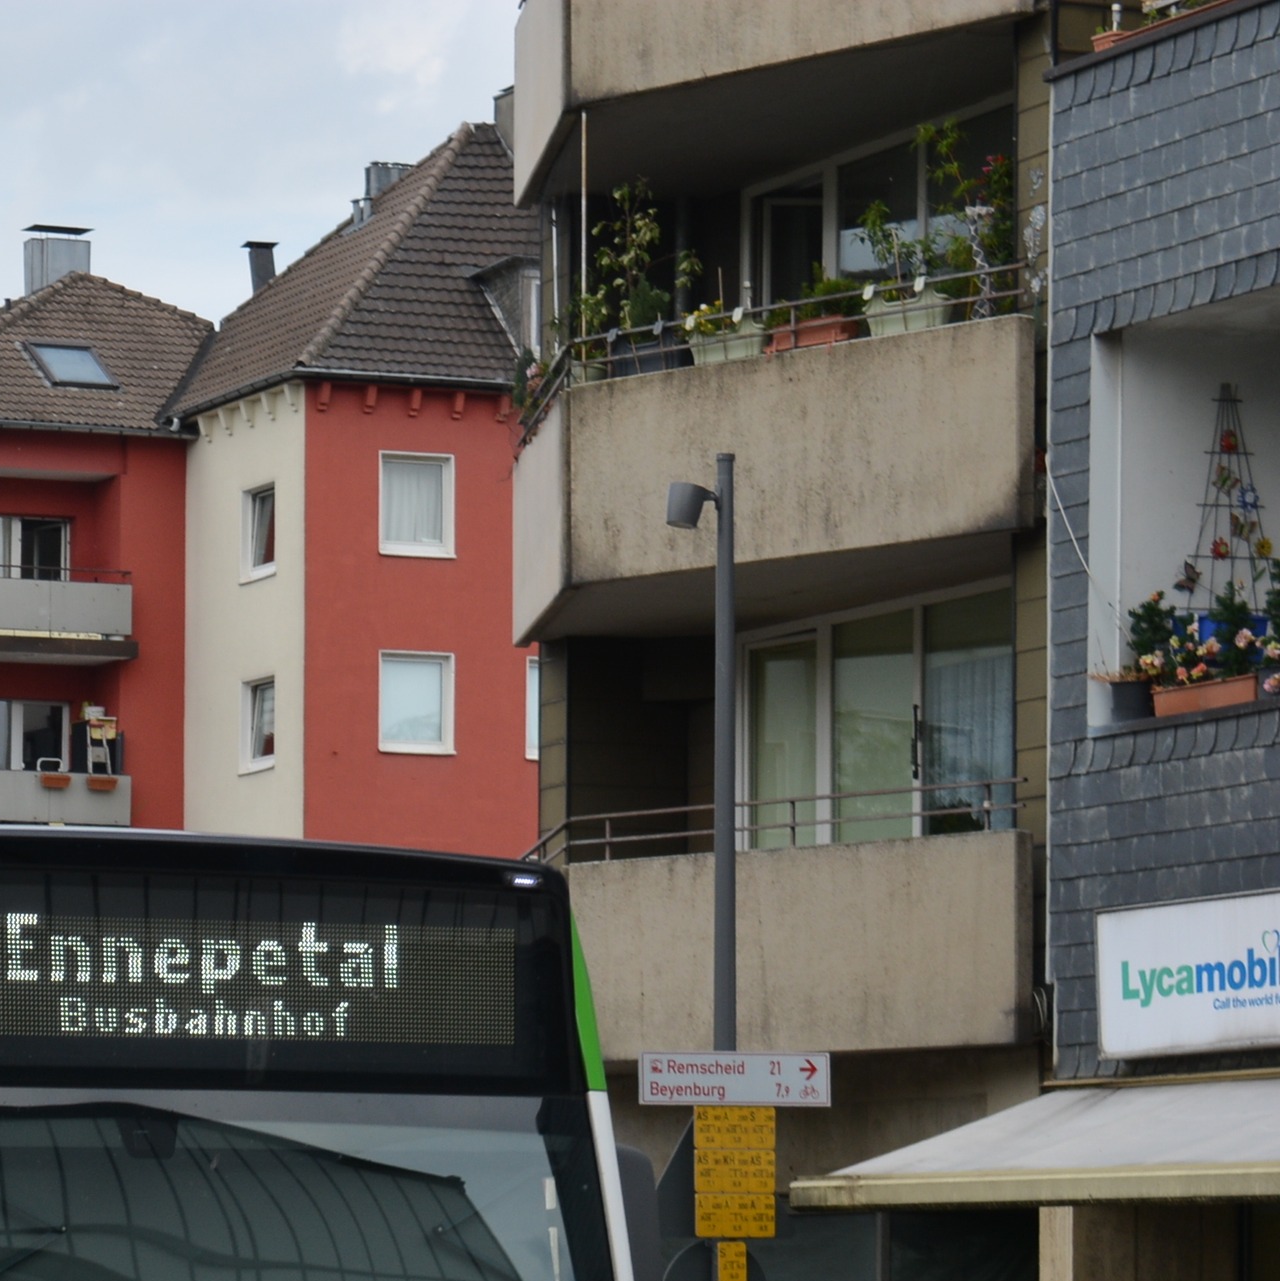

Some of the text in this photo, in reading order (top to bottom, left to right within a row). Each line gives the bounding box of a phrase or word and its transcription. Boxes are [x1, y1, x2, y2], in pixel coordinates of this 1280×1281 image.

[6, 912, 398, 994] Ennepetal
[1121, 946, 1280, 1008] Lycamobi
[1213, 998, 1230, 1010] Call
[1232, 996, 1247, 1008] the
[1248, 993, 1273, 1007] world
[59, 997, 349, 1036] Busbahnhof
[667, 1059, 781, 1076] Remscheid 21
[650, 1081, 726, 1100] Beyenburg
